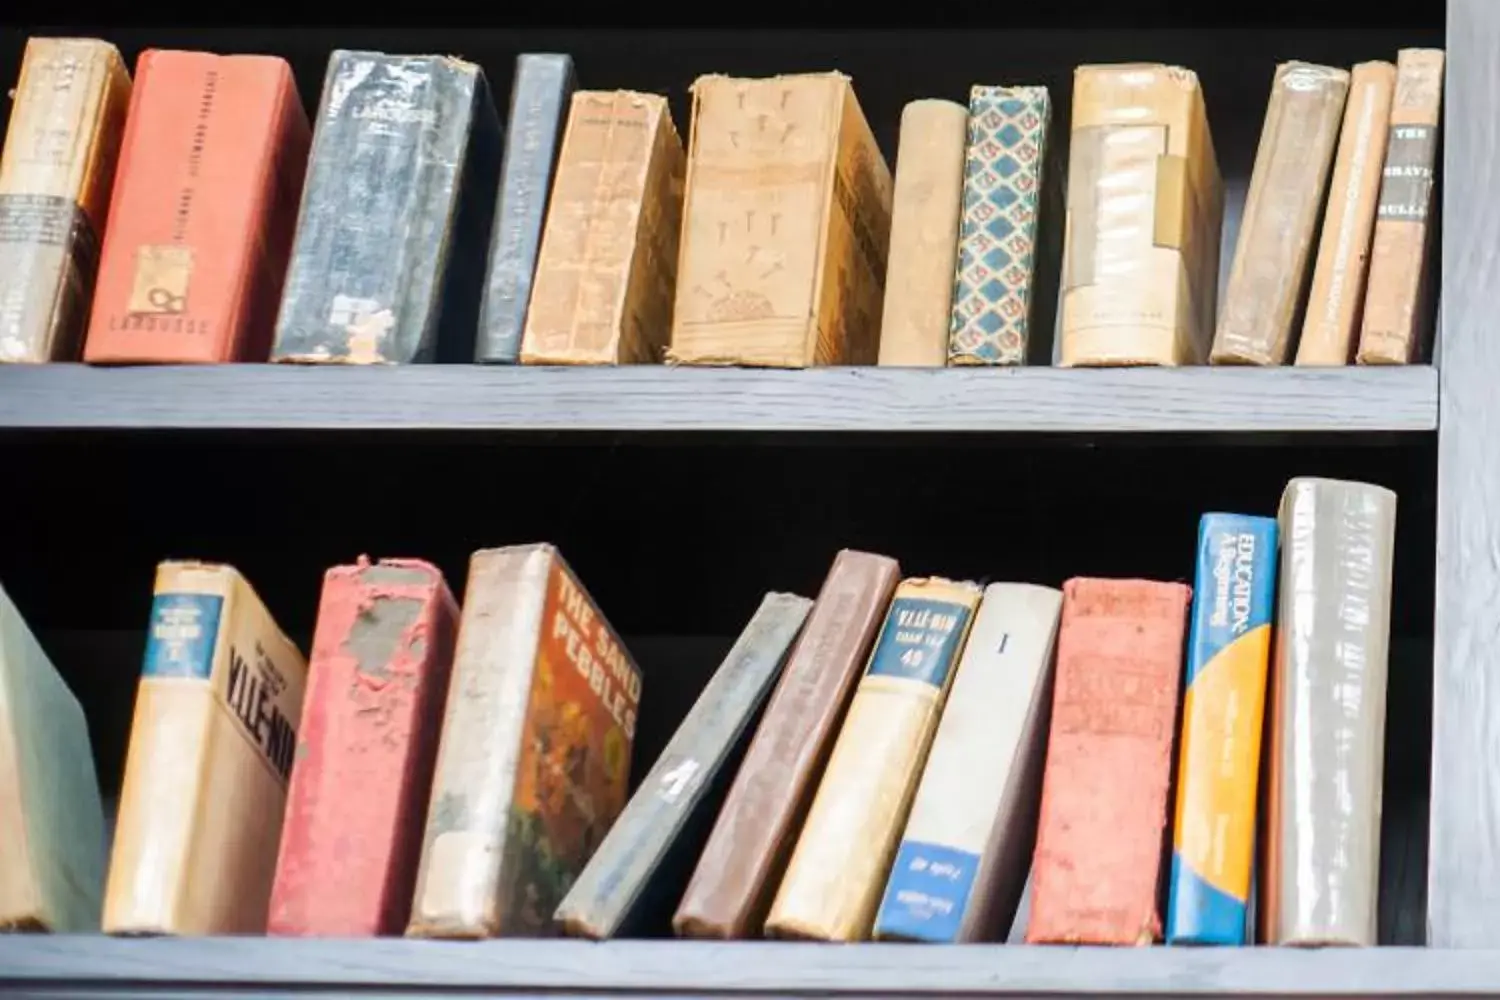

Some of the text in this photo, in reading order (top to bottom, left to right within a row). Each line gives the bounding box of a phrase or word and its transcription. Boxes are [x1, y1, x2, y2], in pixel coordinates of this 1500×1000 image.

[1395, 128, 1427, 139] THE
[552, 612, 638, 741] PEBBLES
[556, 571, 643, 703] THE SAND
